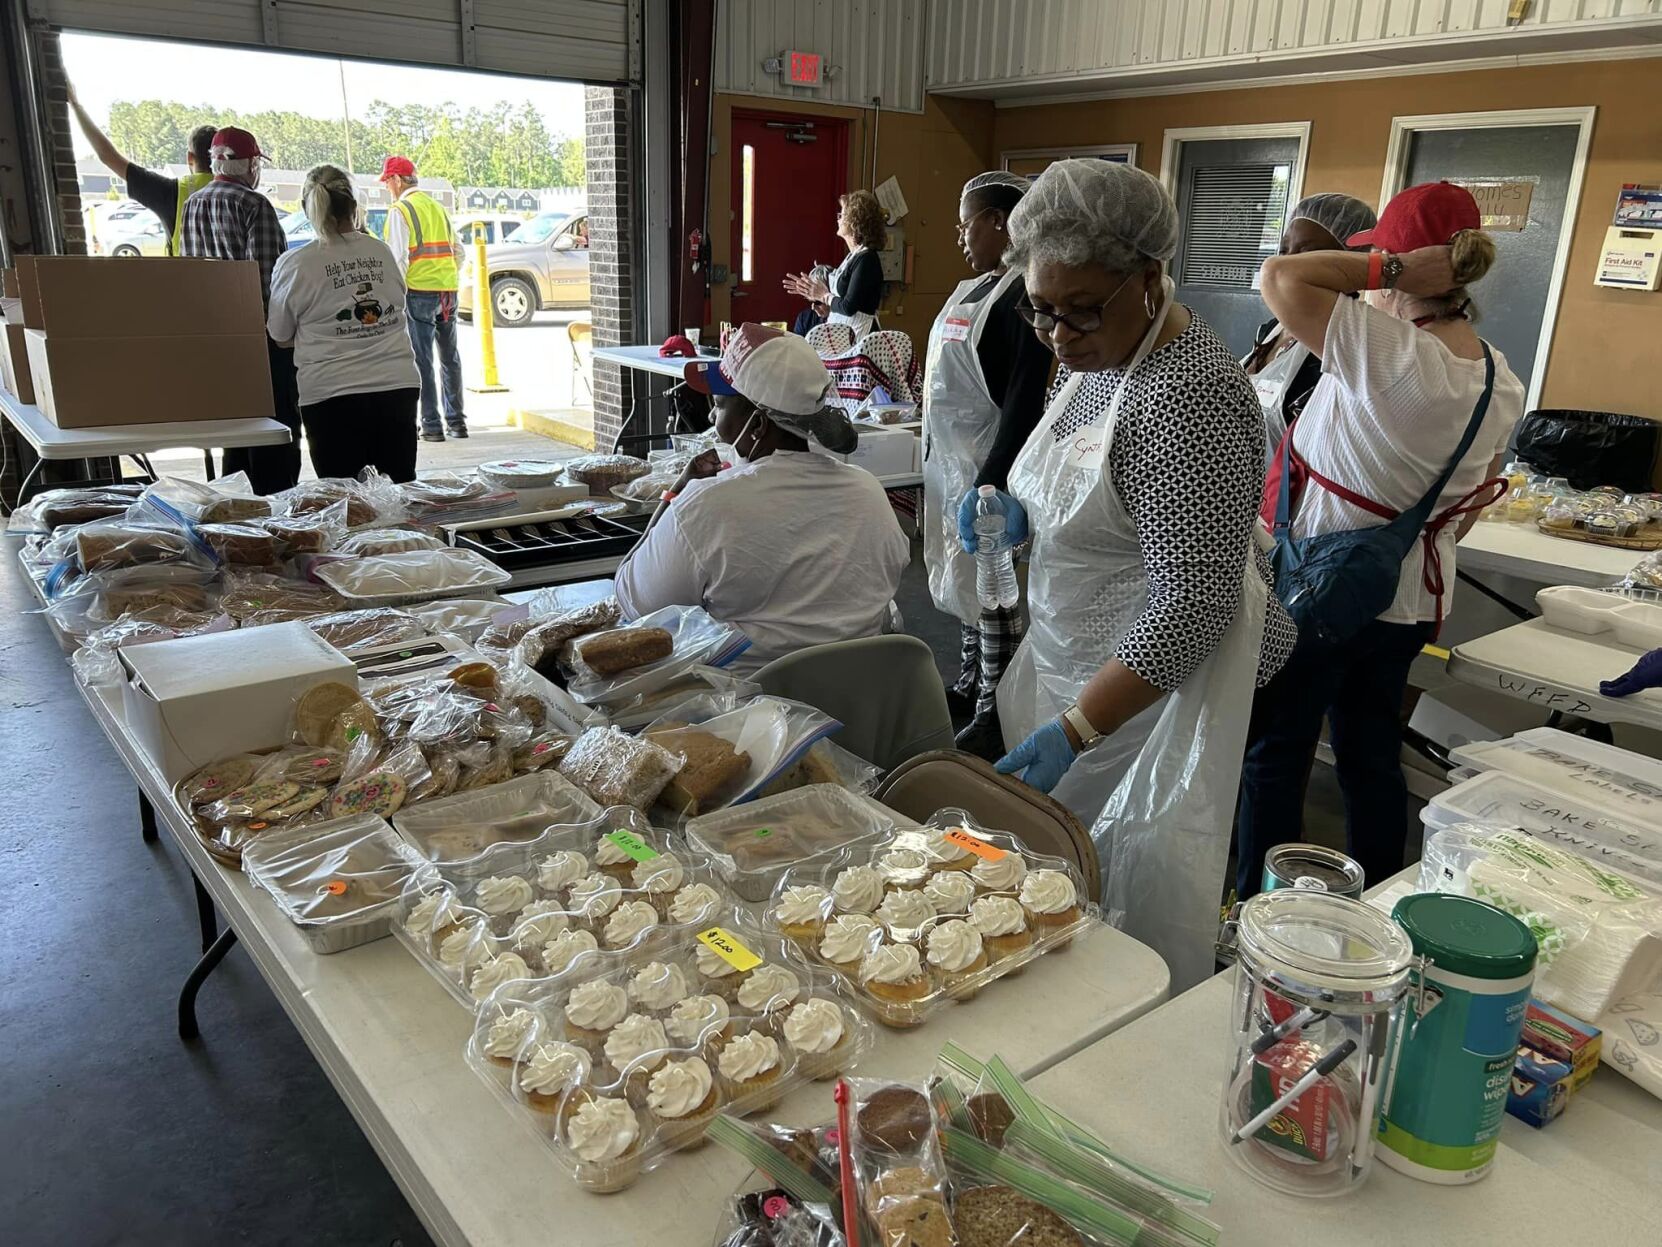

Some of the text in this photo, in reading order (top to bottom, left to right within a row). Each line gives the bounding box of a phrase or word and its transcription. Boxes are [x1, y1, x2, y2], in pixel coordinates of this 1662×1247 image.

[791, 52, 820, 81] EXIT
[325, 263, 341, 277] Help
[333, 277, 346, 289] Eat
[346, 271, 370, 284] Chicken
[1519, 799, 1597, 831] BAKE
